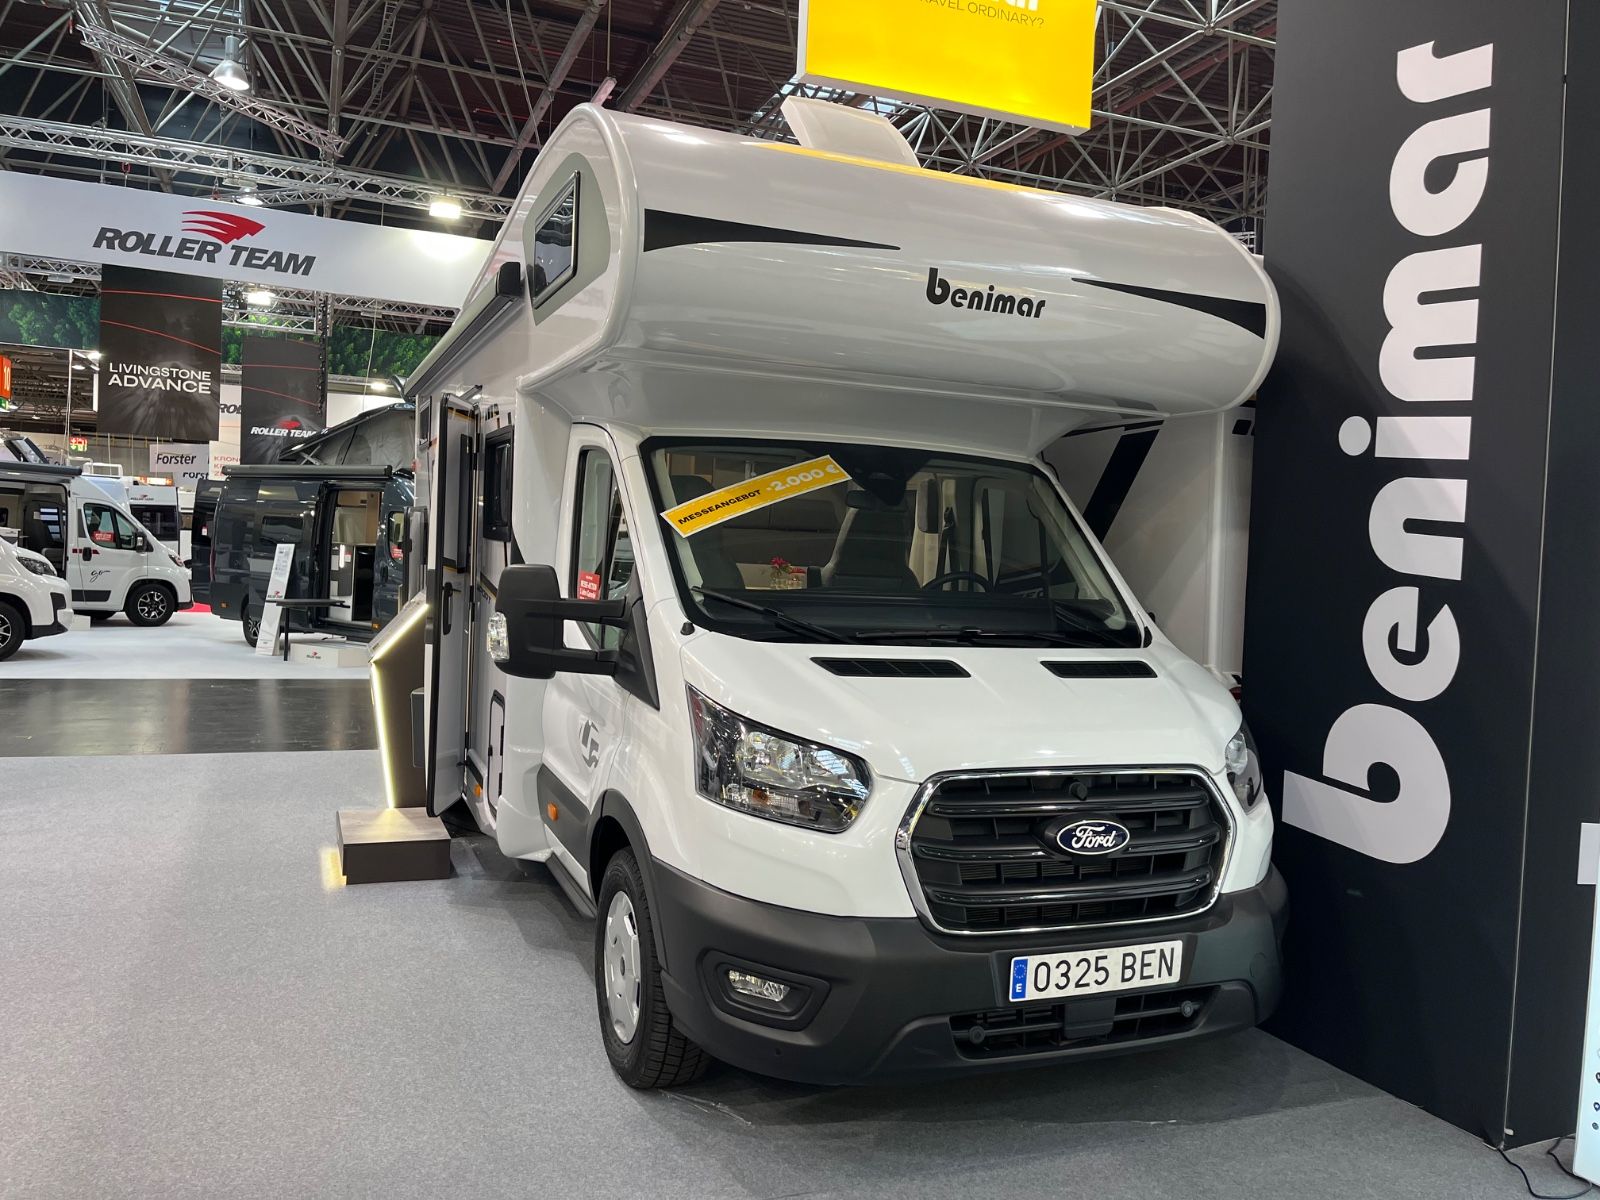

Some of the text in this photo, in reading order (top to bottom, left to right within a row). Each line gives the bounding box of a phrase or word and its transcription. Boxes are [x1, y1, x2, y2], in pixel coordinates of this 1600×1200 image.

[967, 2, 1045, 28] ORDINARY?
[92, 227, 316, 276] ROLLER TEAM
[926, 267, 1046, 318] benimar
[108, 374, 211, 394] ADVANCE
[109, 362, 211, 381] LIVINGSTONE
[250, 426, 288, 437] ROLLER
[156, 454, 197, 465] Forster
[1281, 42, 1494, 864] benimar
[678, 489, 761, 525] MESSEANGEBOT
[1071, 825, 1117, 849] Ford
[1015, 947, 1175, 993] E 0325 BEN
